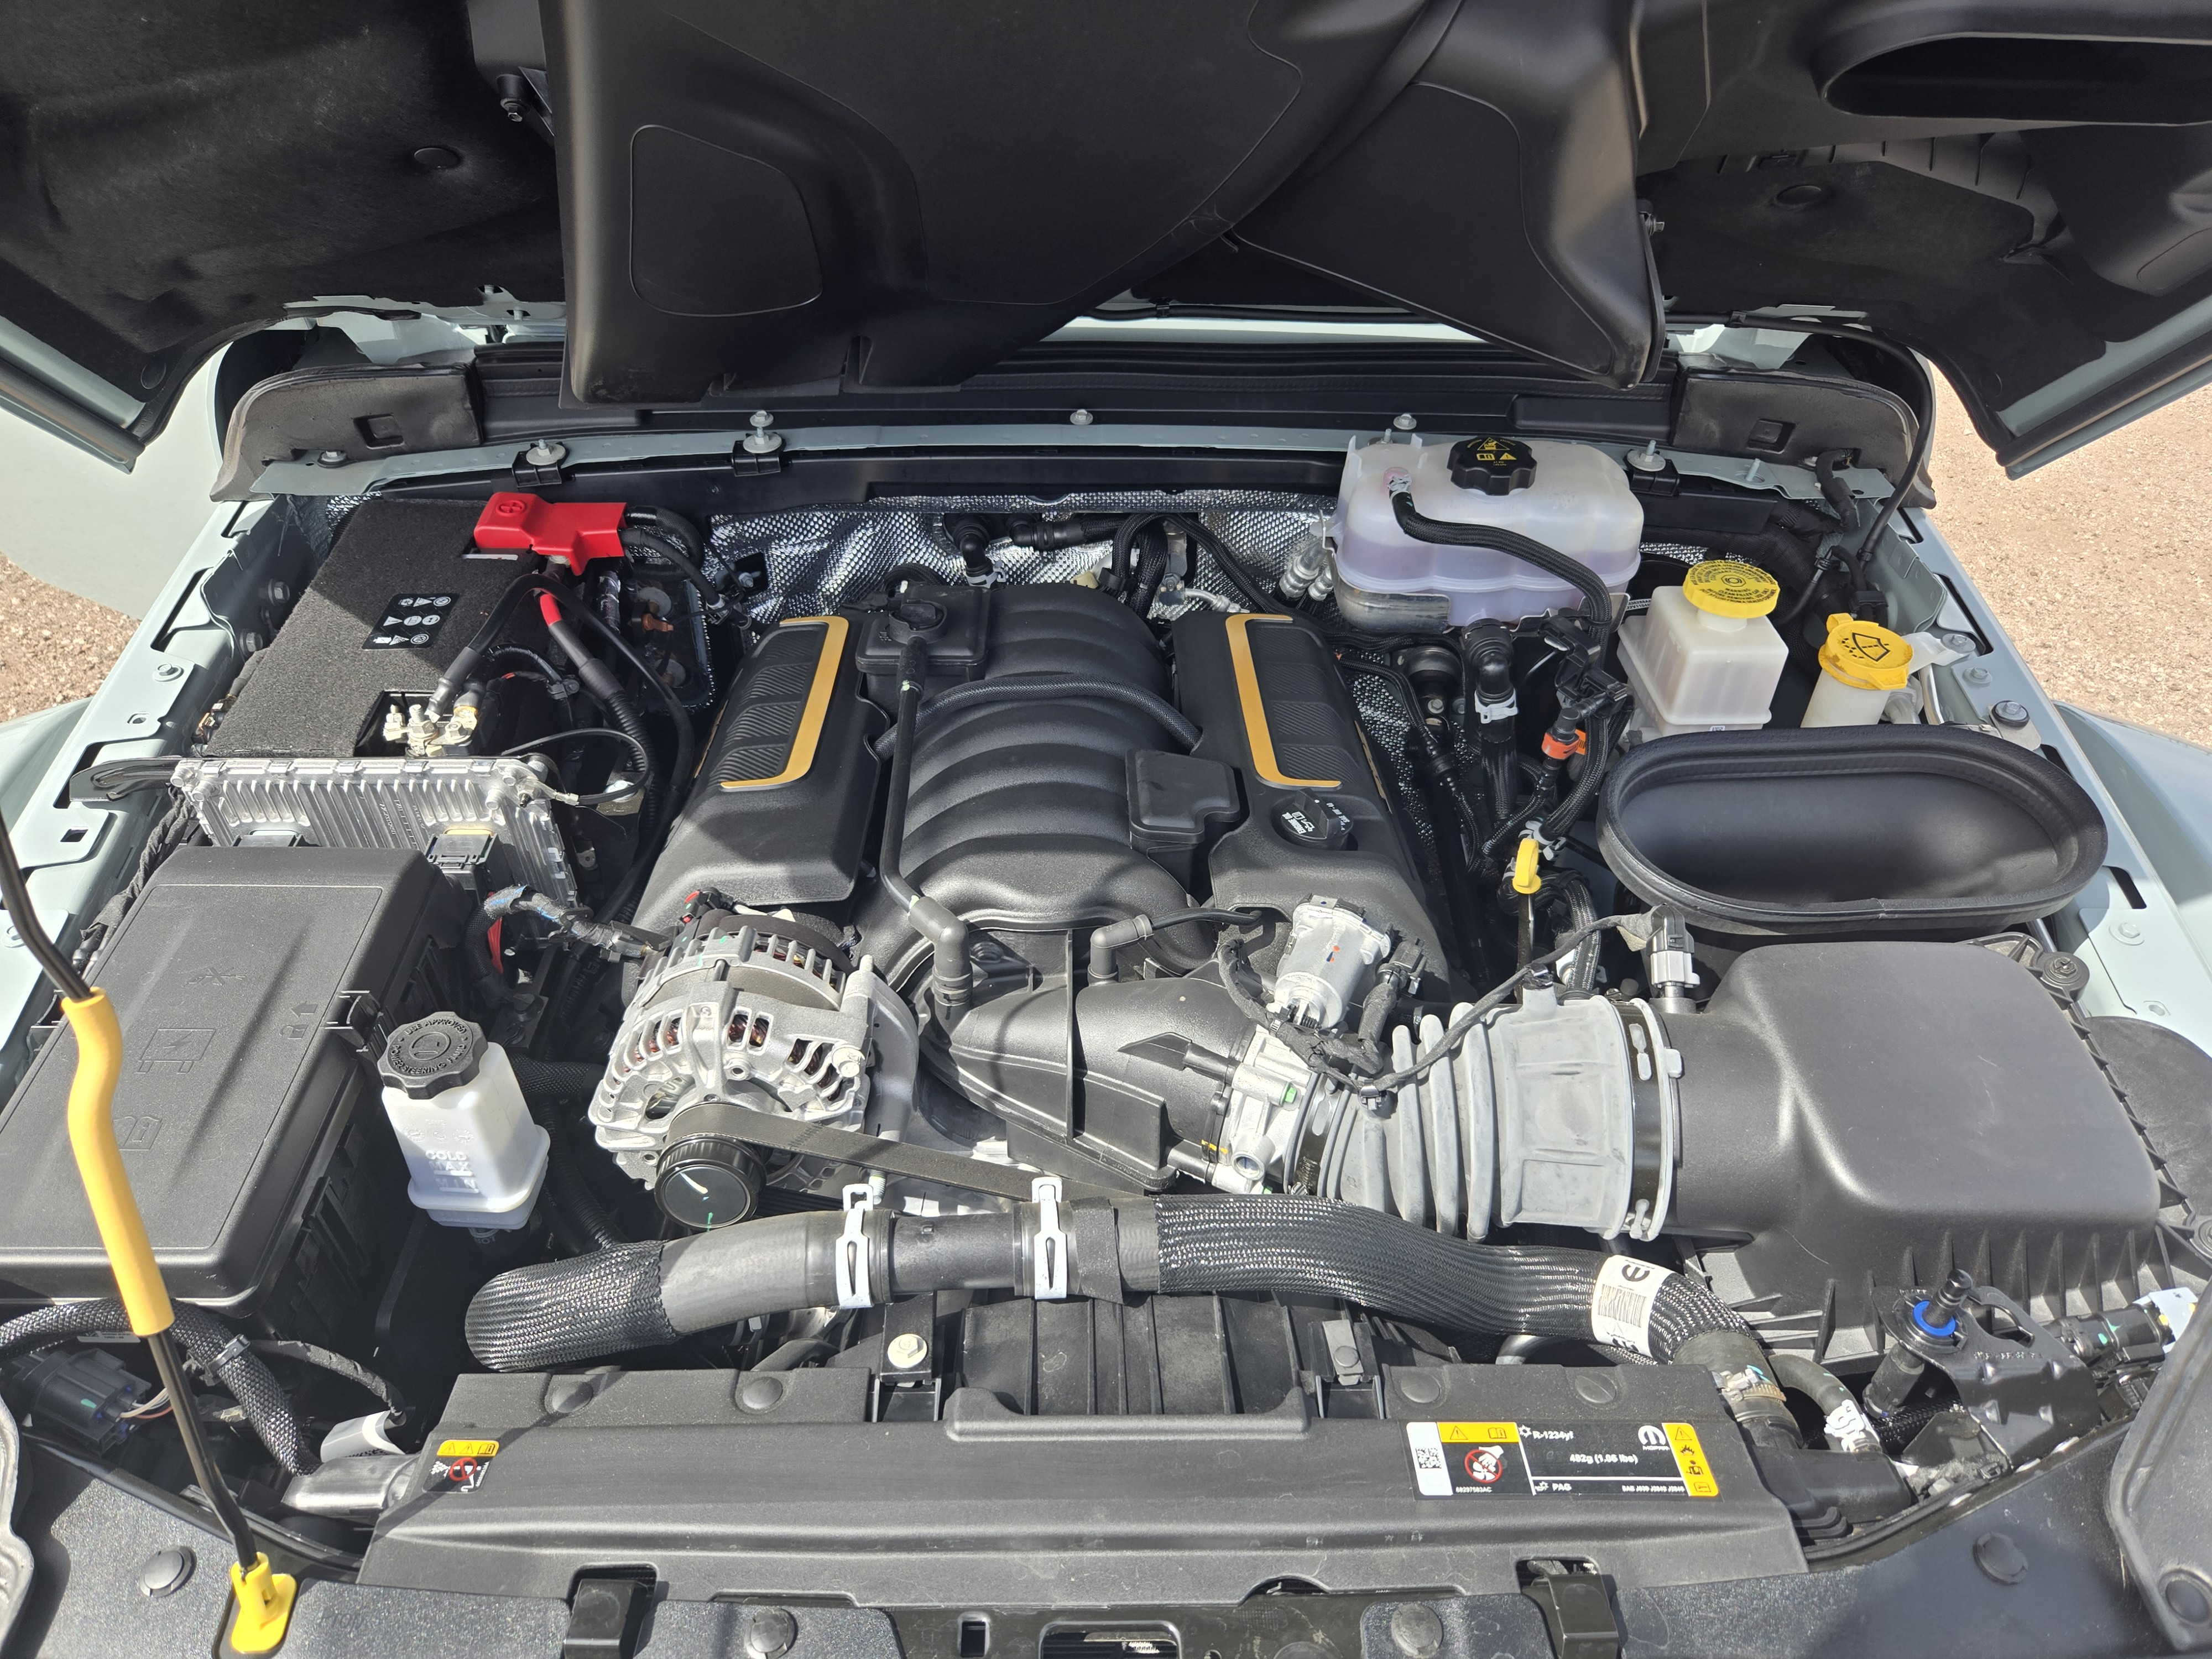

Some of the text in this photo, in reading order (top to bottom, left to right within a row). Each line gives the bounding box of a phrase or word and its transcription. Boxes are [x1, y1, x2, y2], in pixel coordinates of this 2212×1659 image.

[1707, 588, 1725, 597] BEFORE
[404, 1018, 467, 1035] USE APPROVED
[390, 1044, 467, 1074] POWER STEERING FLUID
[425, 1150, 467, 1161] COLD
[429, 1161, 469, 1171] MAX
[435, 1178, 477, 1189] MIN
[1533, 1431, 1574, 1441] R-1234yf
[1569, 1454, 1594, 1464] 482g
[1619, 1454, 1639, 1465] lbs)
[1552, 1483, 1572, 1491] PAG
